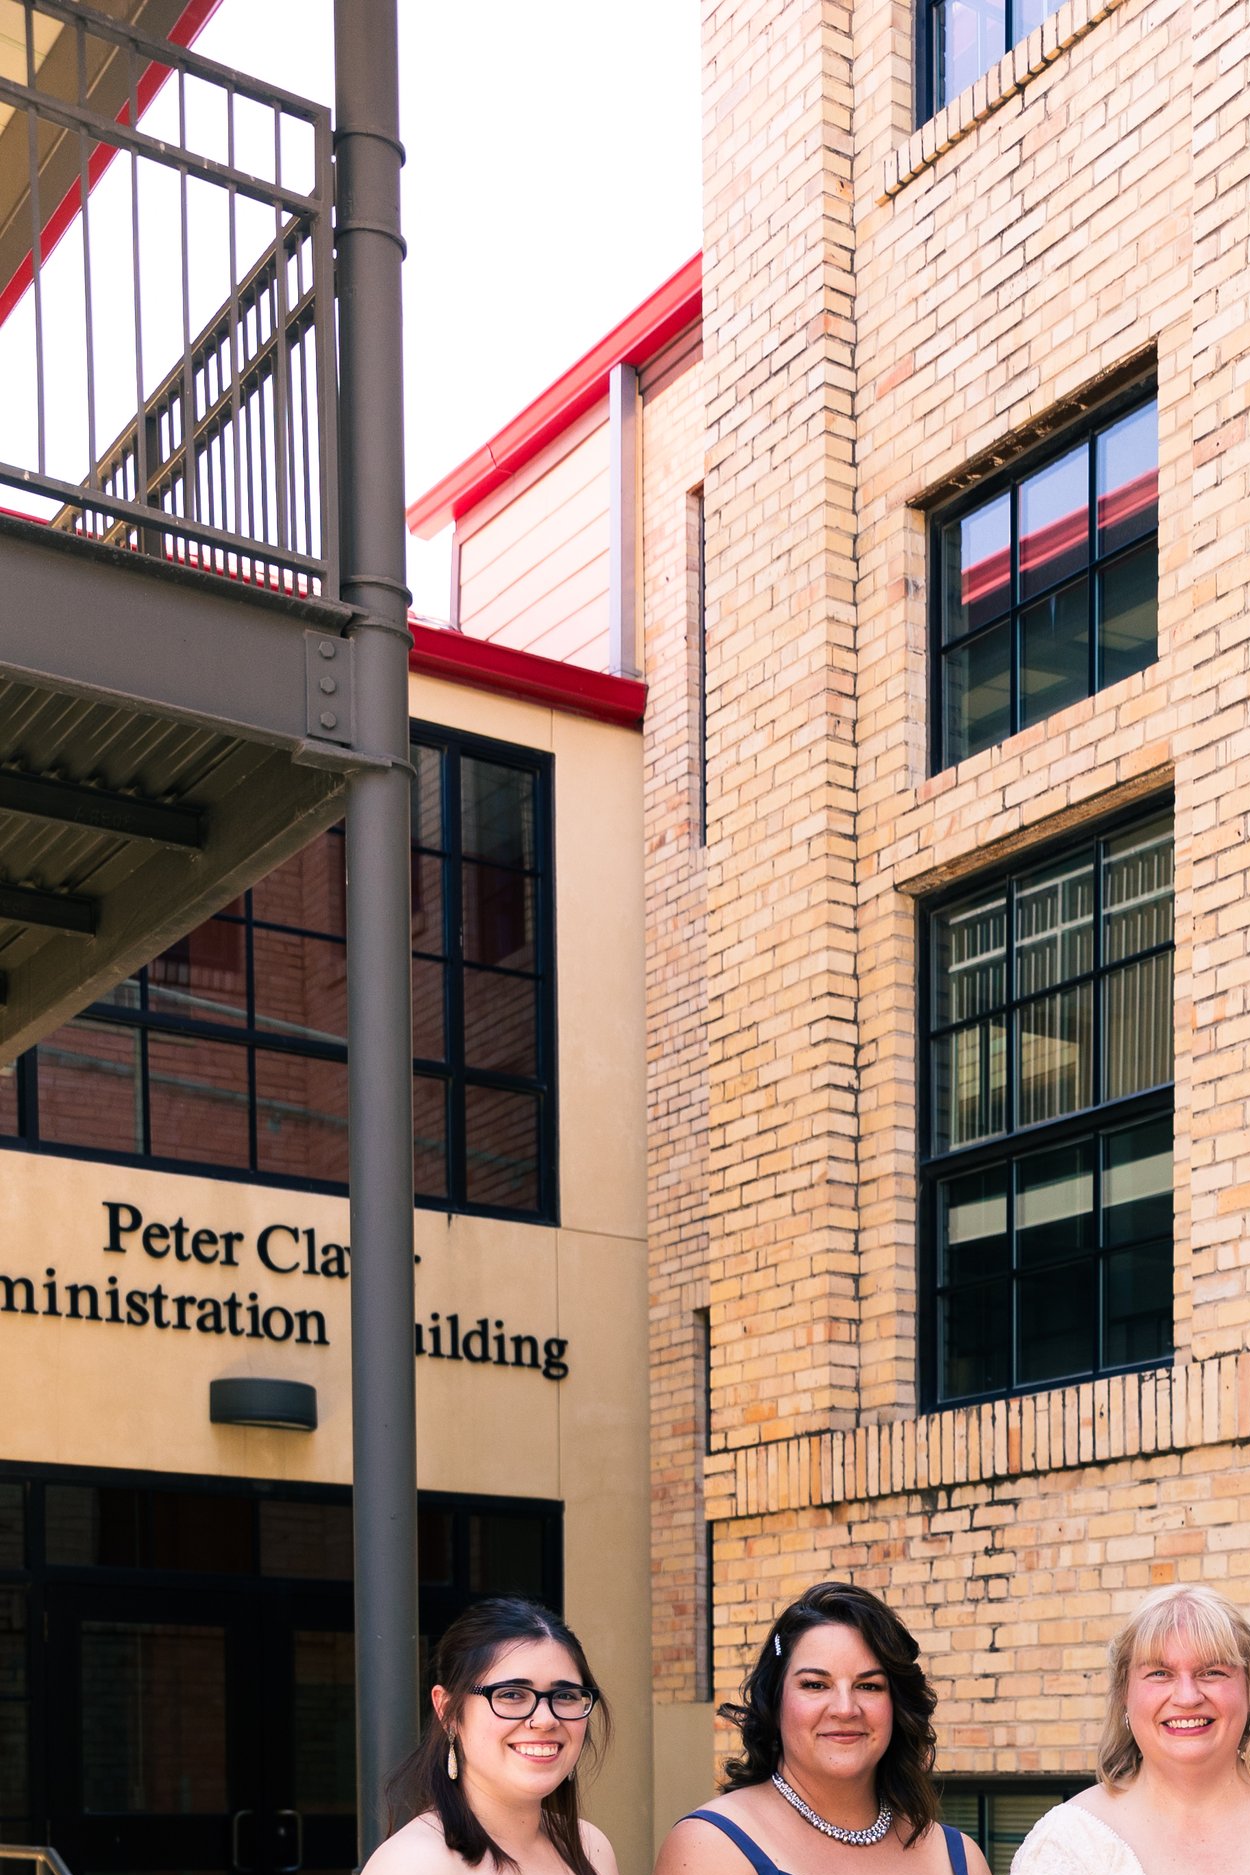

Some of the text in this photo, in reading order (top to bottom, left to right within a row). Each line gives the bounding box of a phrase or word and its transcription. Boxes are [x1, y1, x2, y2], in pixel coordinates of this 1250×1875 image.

[102, 1201, 421, 1280] Peter Cla
[415, 1312, 569, 1384] ilding
